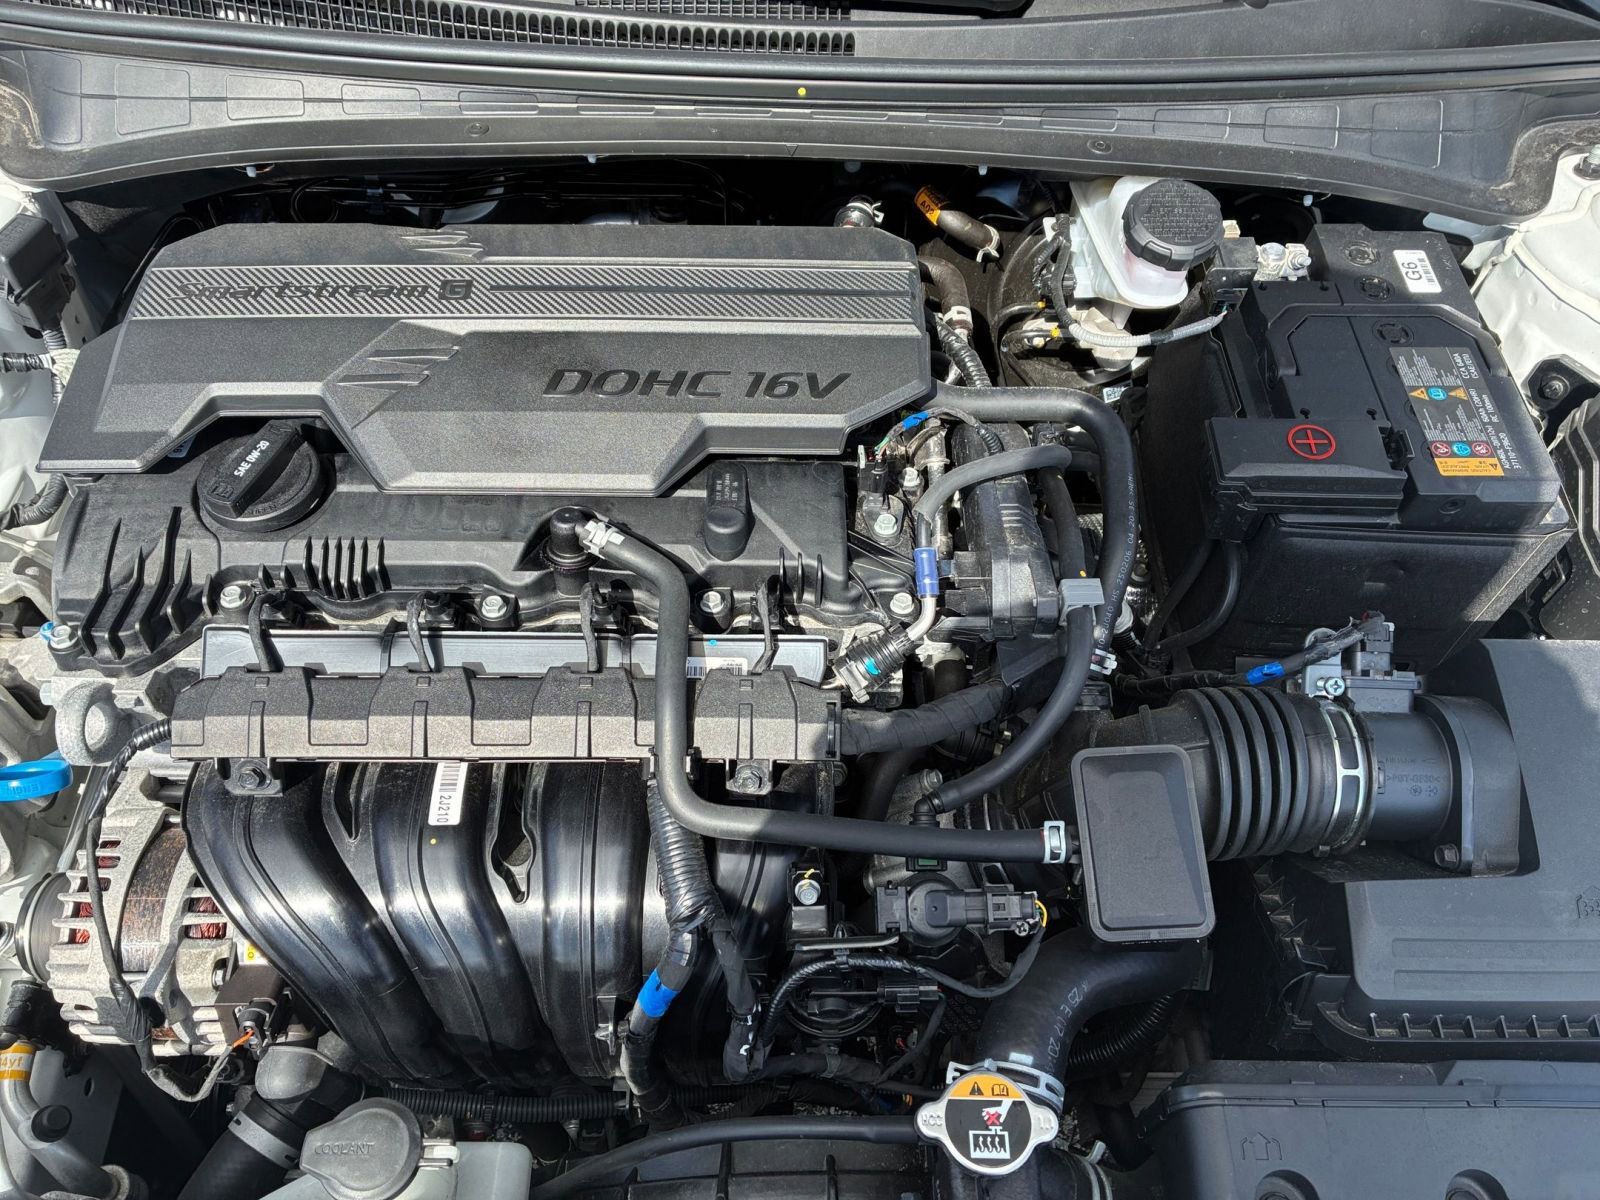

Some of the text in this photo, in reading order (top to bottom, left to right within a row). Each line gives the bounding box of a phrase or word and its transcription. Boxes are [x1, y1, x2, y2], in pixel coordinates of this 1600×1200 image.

[1401, 262, 1423, 281] G6
[167, 280, 429, 300] Smartstream
[543, 368, 852, 400] DOHC 16V
[234, 440, 270, 477] SAE 0W-20
[436, 795, 452, 823] 2J210
[314, 1141, 375, 1156] COOLANT
